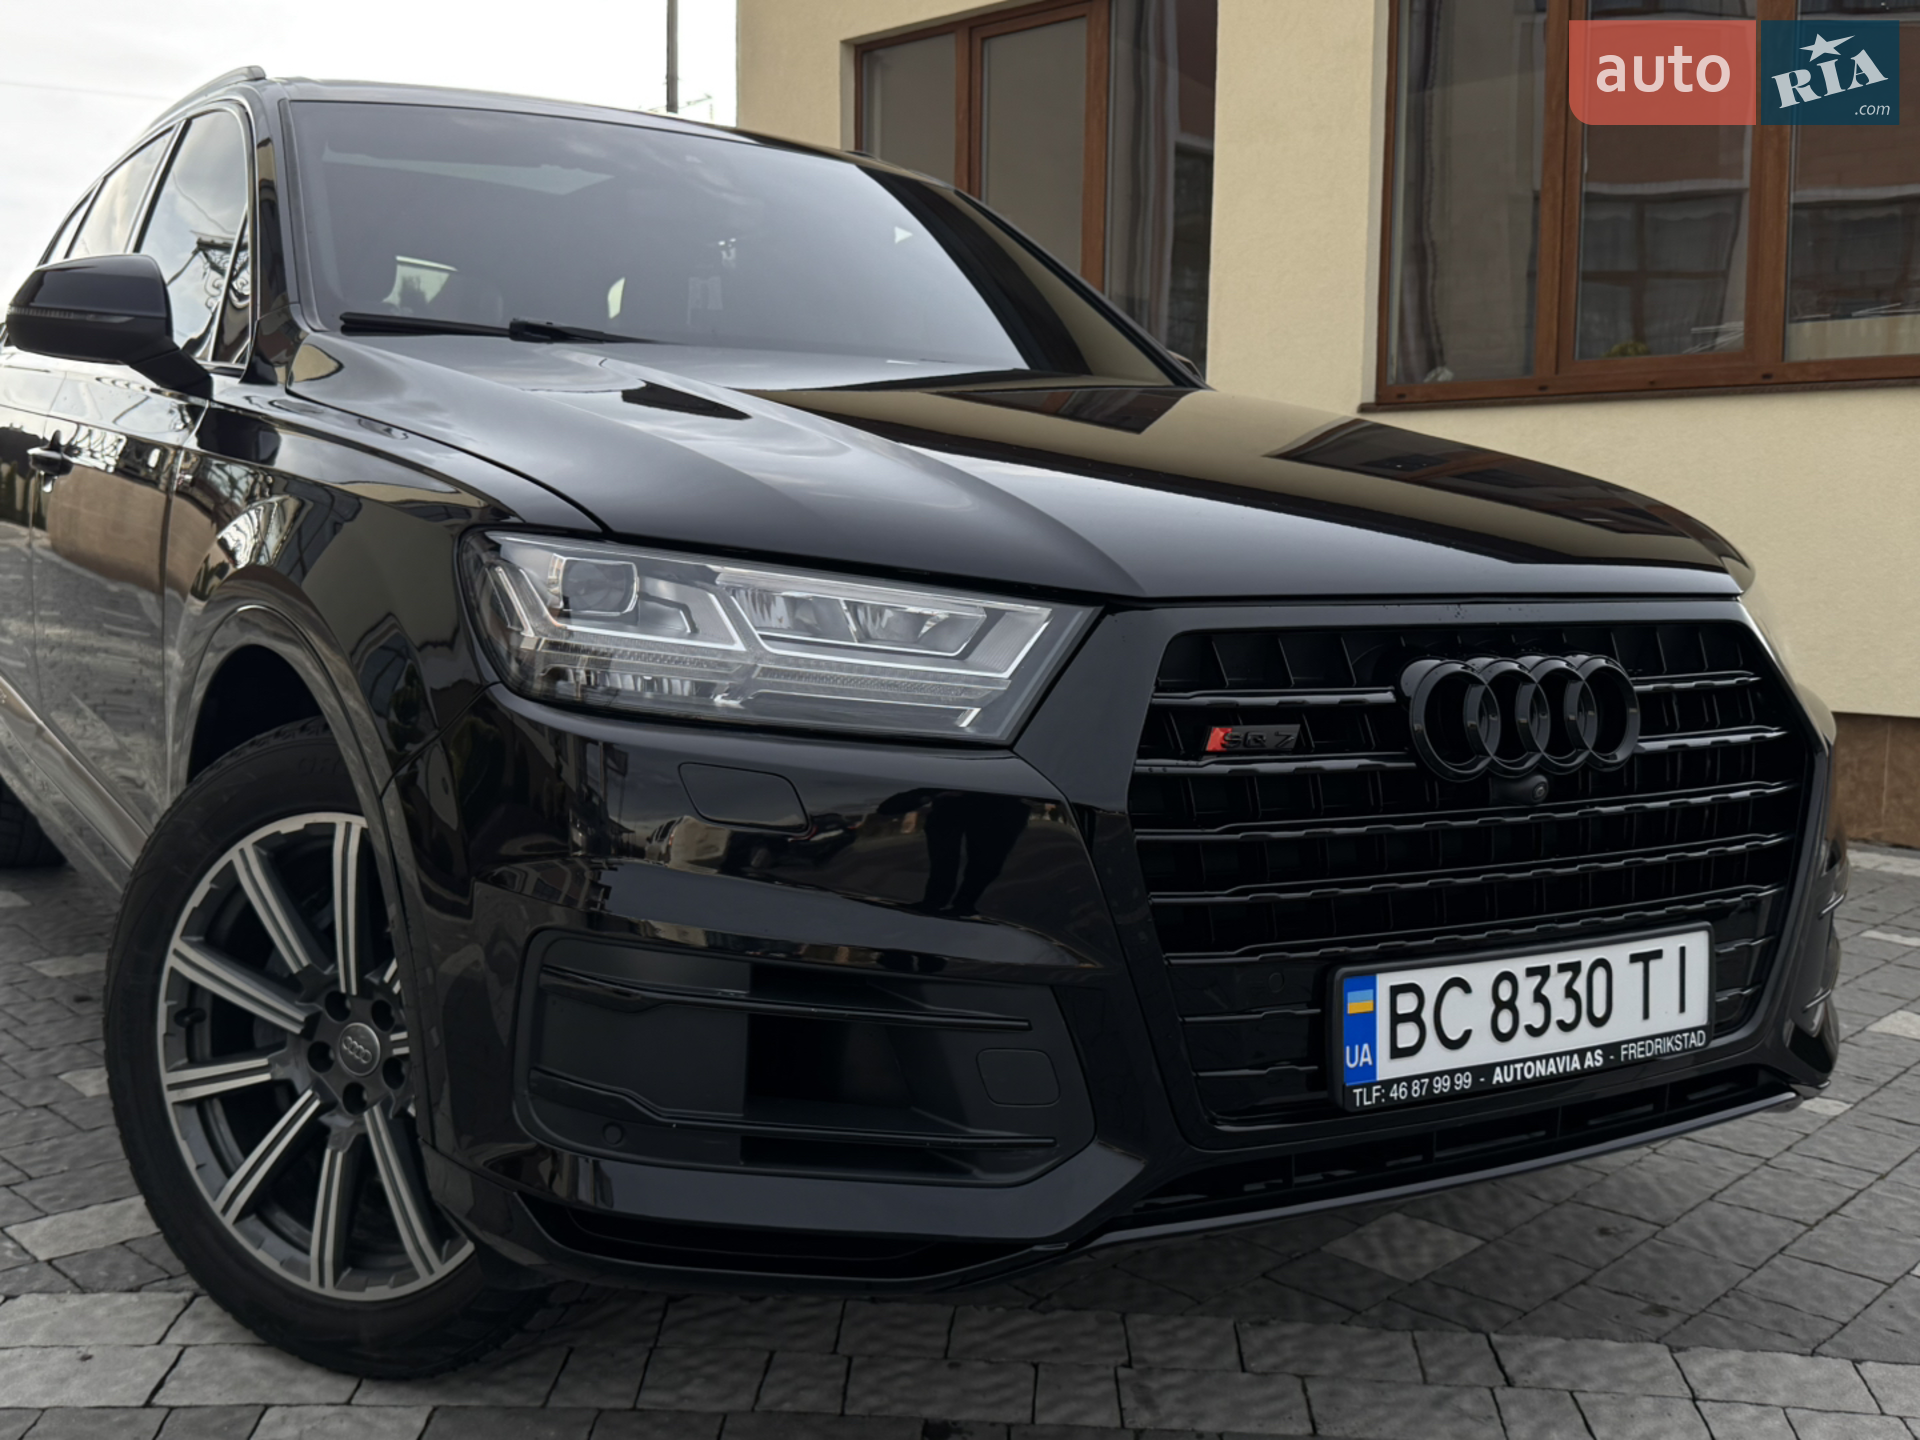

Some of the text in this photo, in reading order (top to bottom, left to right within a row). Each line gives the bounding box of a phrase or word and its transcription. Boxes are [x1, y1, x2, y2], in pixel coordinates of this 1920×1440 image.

[1389, 945, 1686, 1060] BC 8330 TI
[1345, 1043, 1374, 1069] UA
[1352, 1084, 1386, 1107] TLF:
[1389, 1081, 1408, 1101] 46
[1411, 1078, 1430, 1098] 87
[1432, 1074, 1450, 1095] 99
[1453, 1071, 1473, 1091] 99
[1491, 1052, 1581, 1085] AUTONAVIA
[1583, 1048, 1605, 1070] AS
[1620, 1029, 1707, 1063] FREDRIKSTAD
